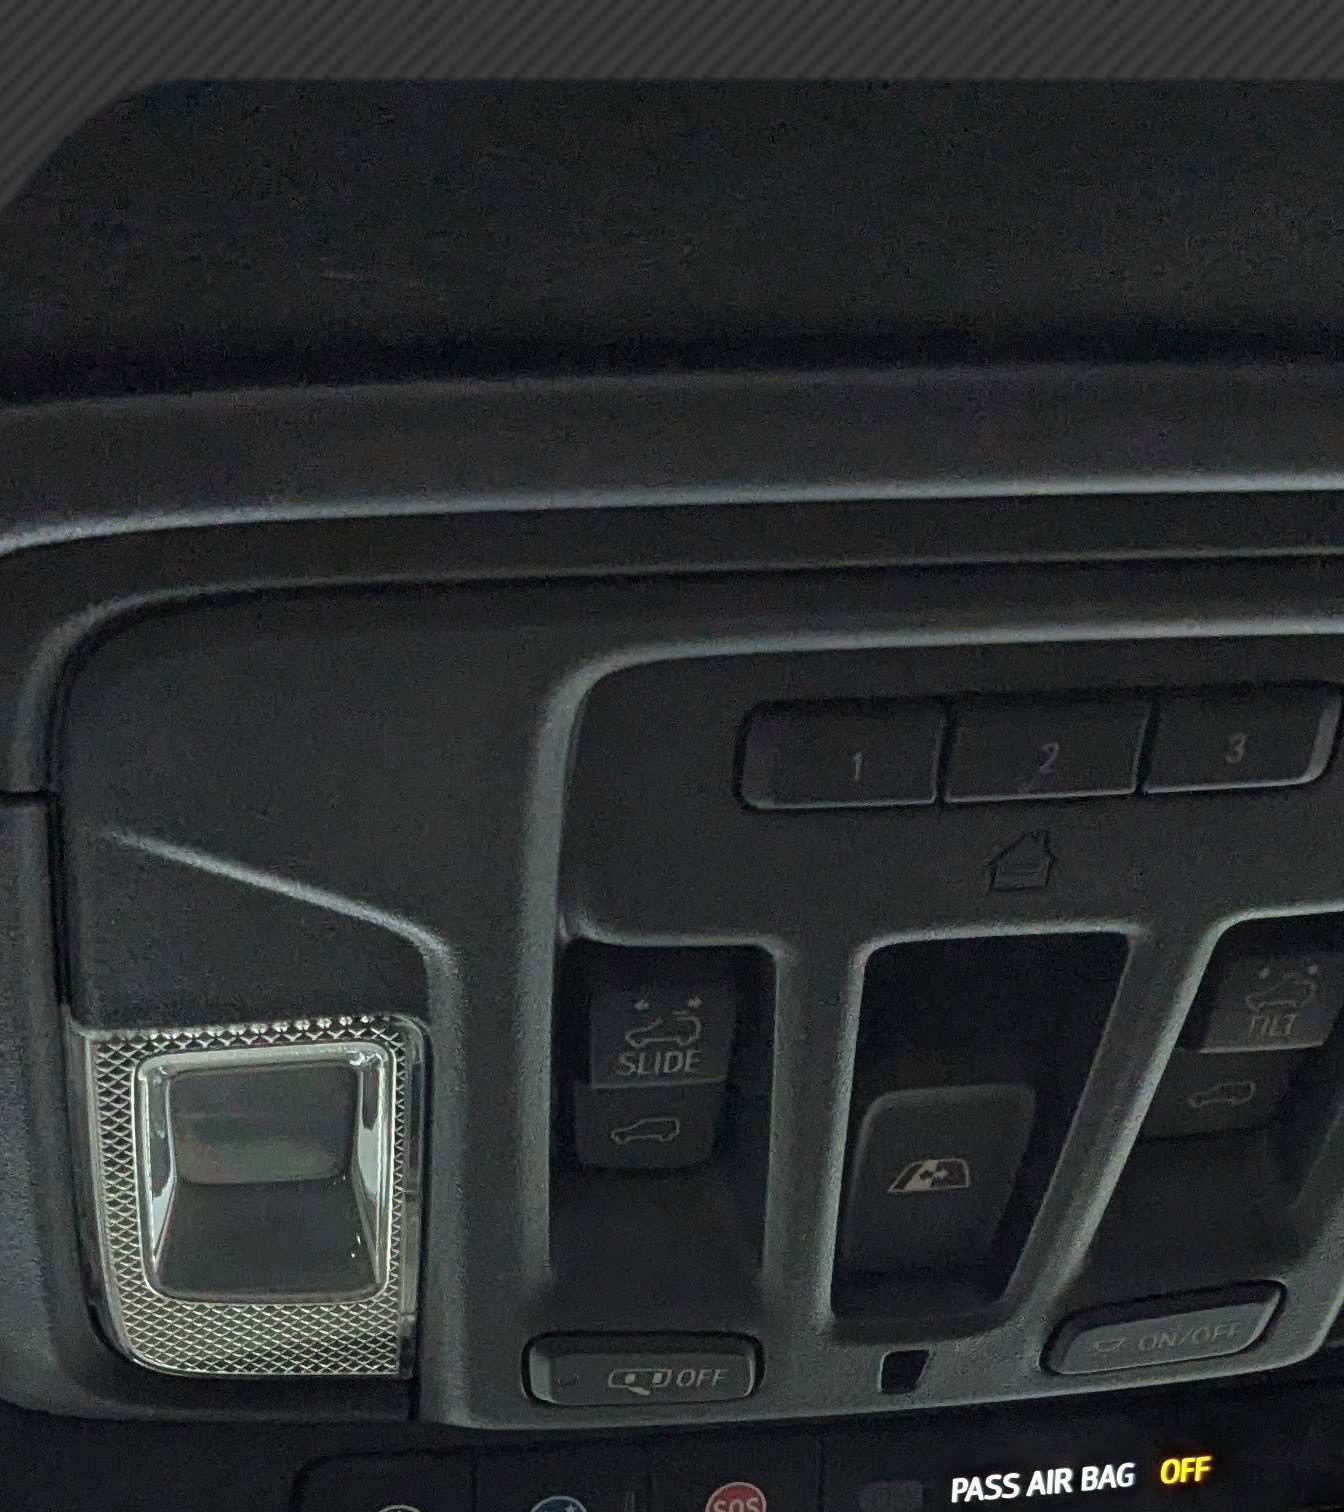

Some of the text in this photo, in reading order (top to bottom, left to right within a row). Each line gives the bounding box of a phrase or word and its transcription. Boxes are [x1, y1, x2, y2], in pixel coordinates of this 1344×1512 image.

[1039, 742, 1061, 774] 2
[1225, 733, 1248, 764] 3
[852, 750, 864, 782] 1
[1246, 1012, 1299, 1039] TILT
[615, 1049, 703, 1077] SLIDE
[1138, 1322, 1242, 1352] ON/OFF
[675, 1369, 726, 1388] OFF
[951, 1455, 1212, 1503] PASS AIR BAG OFF
